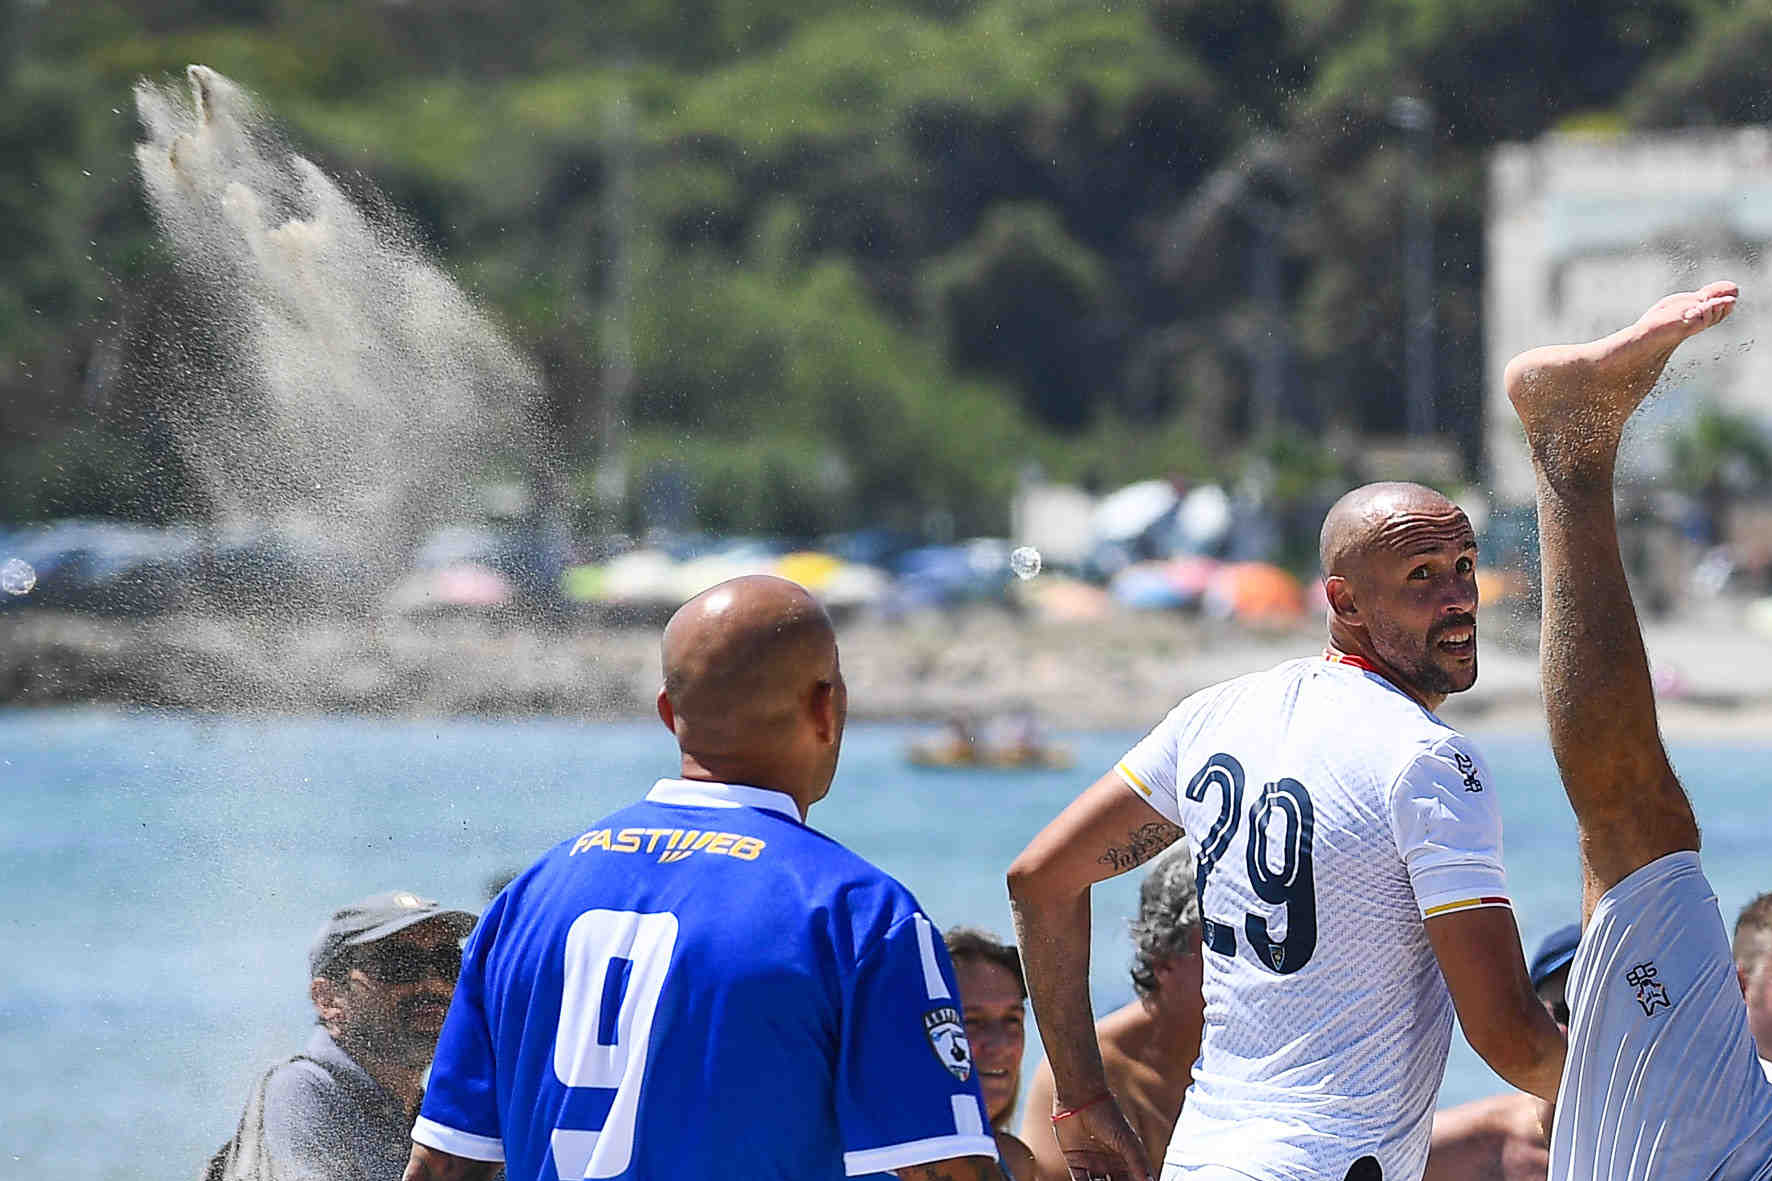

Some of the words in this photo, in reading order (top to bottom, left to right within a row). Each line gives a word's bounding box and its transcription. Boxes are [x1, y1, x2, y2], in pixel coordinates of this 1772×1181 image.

[569, 828, 767, 863] FASTWEB
[1186, 753, 1317, 975] 29
[551, 908, 679, 1181] 9
